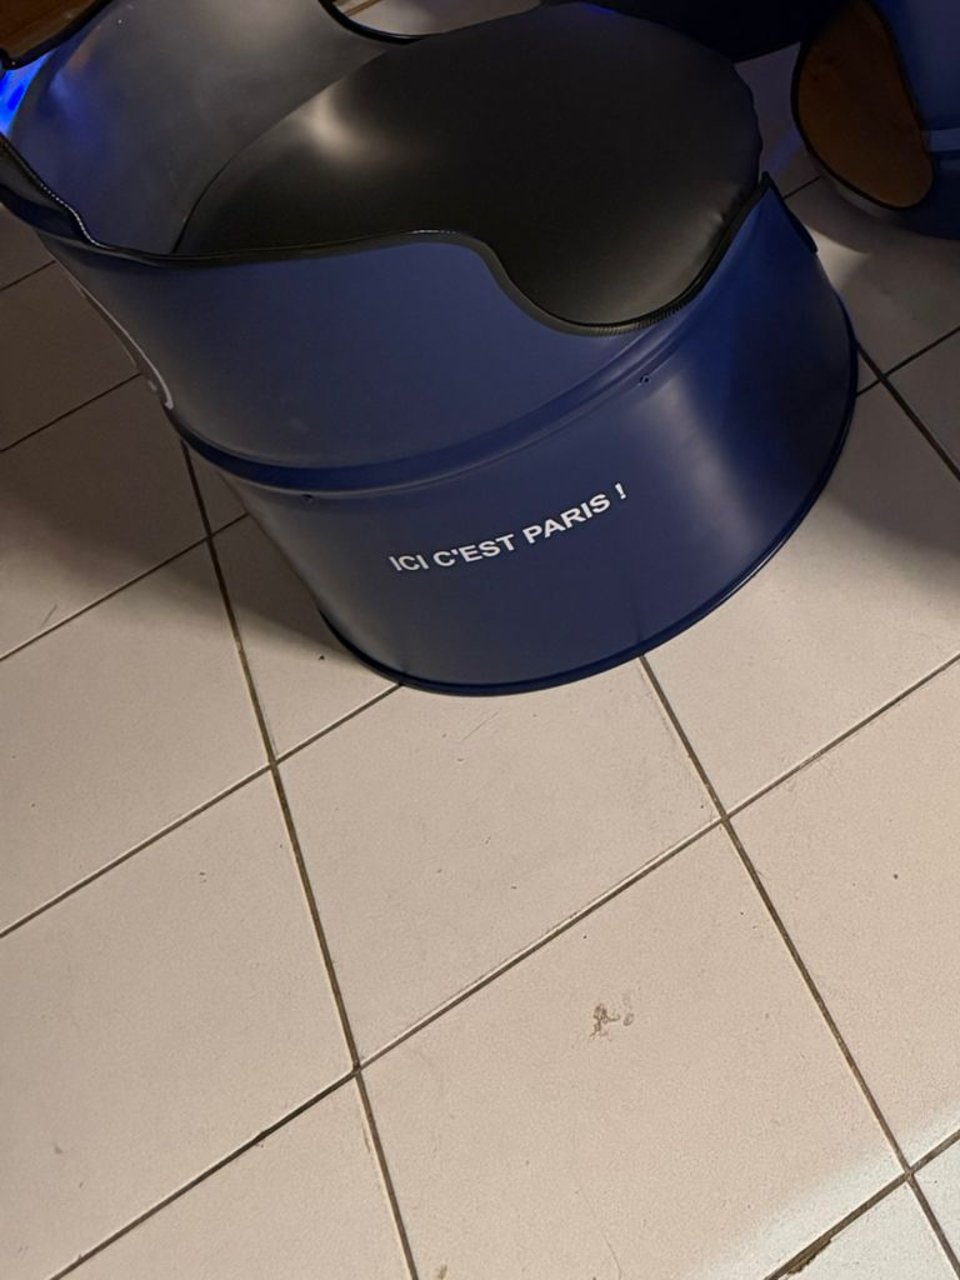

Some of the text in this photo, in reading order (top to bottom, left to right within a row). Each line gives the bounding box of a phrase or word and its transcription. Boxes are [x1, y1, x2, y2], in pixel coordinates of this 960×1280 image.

[388, 554, 429, 571] ICI
[433, 533, 515, 567] C'EST
[522, 493, 611, 544] PARIS
